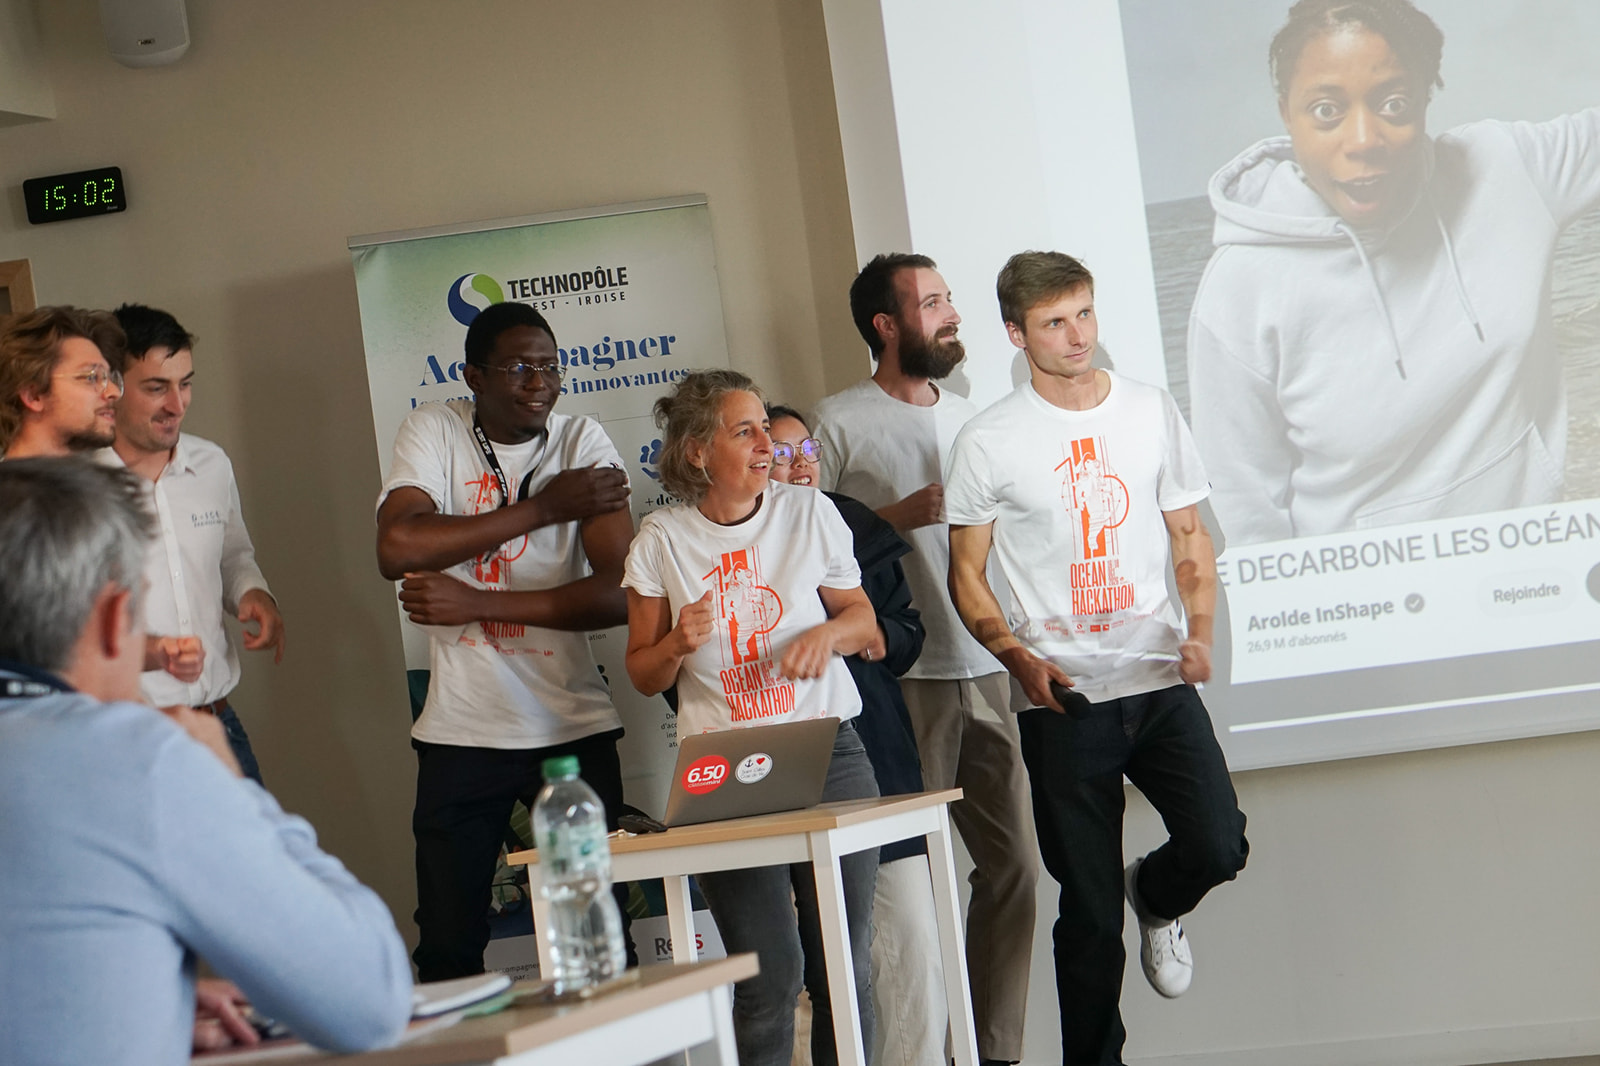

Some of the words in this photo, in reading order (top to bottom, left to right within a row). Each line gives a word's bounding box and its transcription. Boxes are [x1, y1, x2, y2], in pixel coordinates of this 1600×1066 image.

[44, 177, 116, 211] 15:02
[507, 265, 629, 299] TECHNOPÔLE
[532, 300, 556, 312] EST
[578, 291, 626, 306] IROISE
[418, 335, 676, 386] Acpagner
[1237, 535, 1426, 585] DECARBONE
[1433, 526, 1490, 559] LES
[1070, 560, 1107, 589] OCEAN
[1072, 583, 1135, 615] HACKATHON
[1493, 582, 1561, 603] Rejoindre
[1247, 608, 1311, 632] Arolde
[1316, 600, 1395, 623] InShape
[1247, 638, 1271, 653] 26,9
[1274, 637, 1286, 649] M
[1288, 631, 1348, 648] d'abonnés
[720, 662, 763, 695] OCEAN
[725, 682, 796, 722] HACKATHON
[687, 764, 725, 783] 6.50
